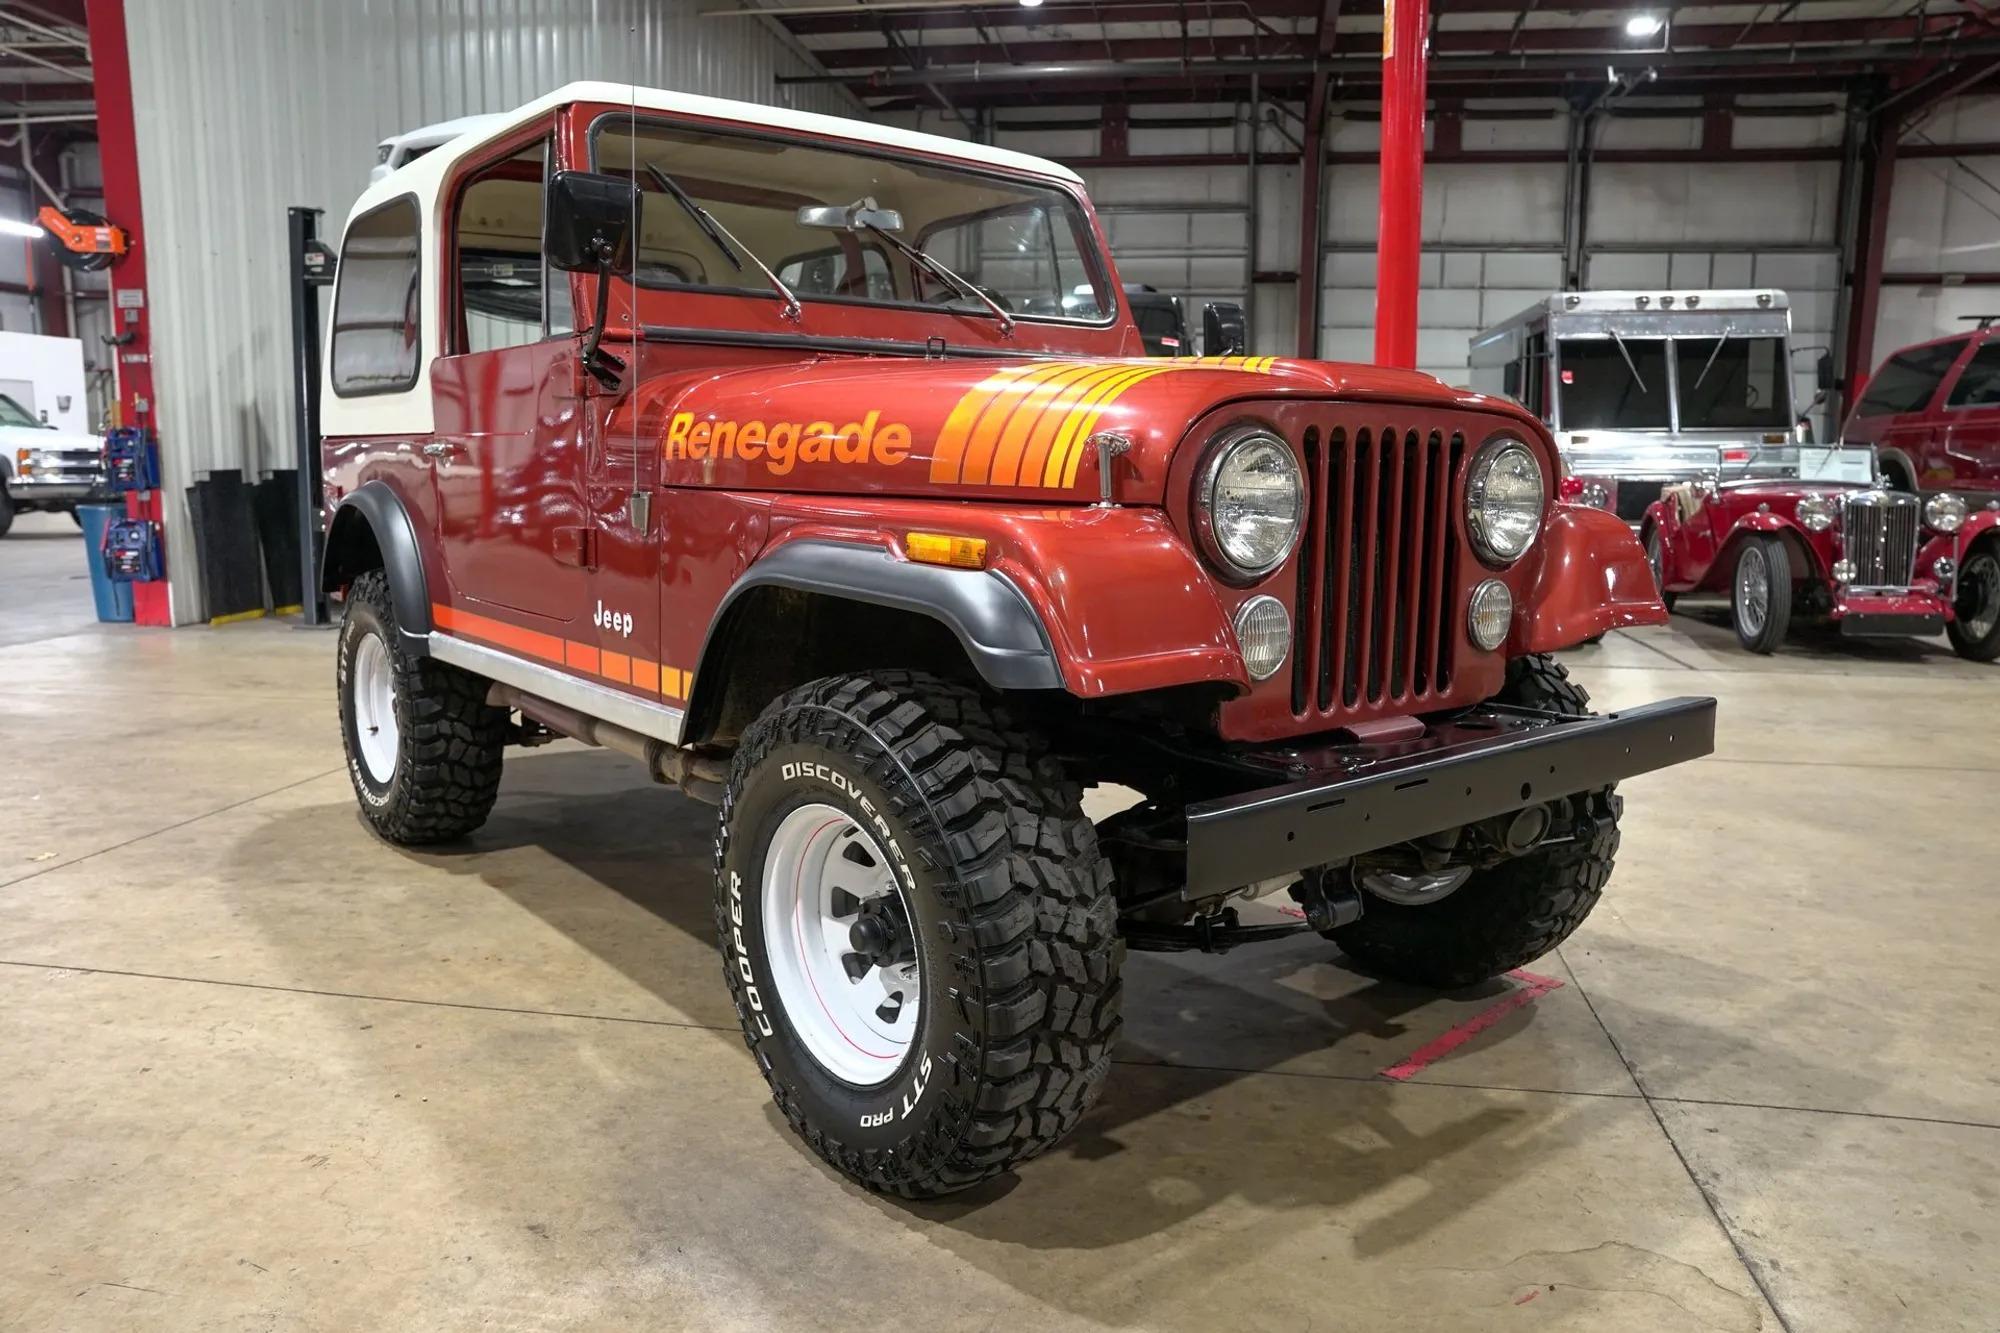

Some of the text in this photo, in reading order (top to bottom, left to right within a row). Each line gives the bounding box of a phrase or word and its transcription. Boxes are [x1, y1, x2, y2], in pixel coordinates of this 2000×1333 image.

[665, 409, 912, 476] Renegade
[593, 599, 633, 638] Jeep
[781, 762, 917, 890] DISCOVERER
[730, 870, 774, 1037] COOPER
[859, 1049, 933, 1128] STT PRO
